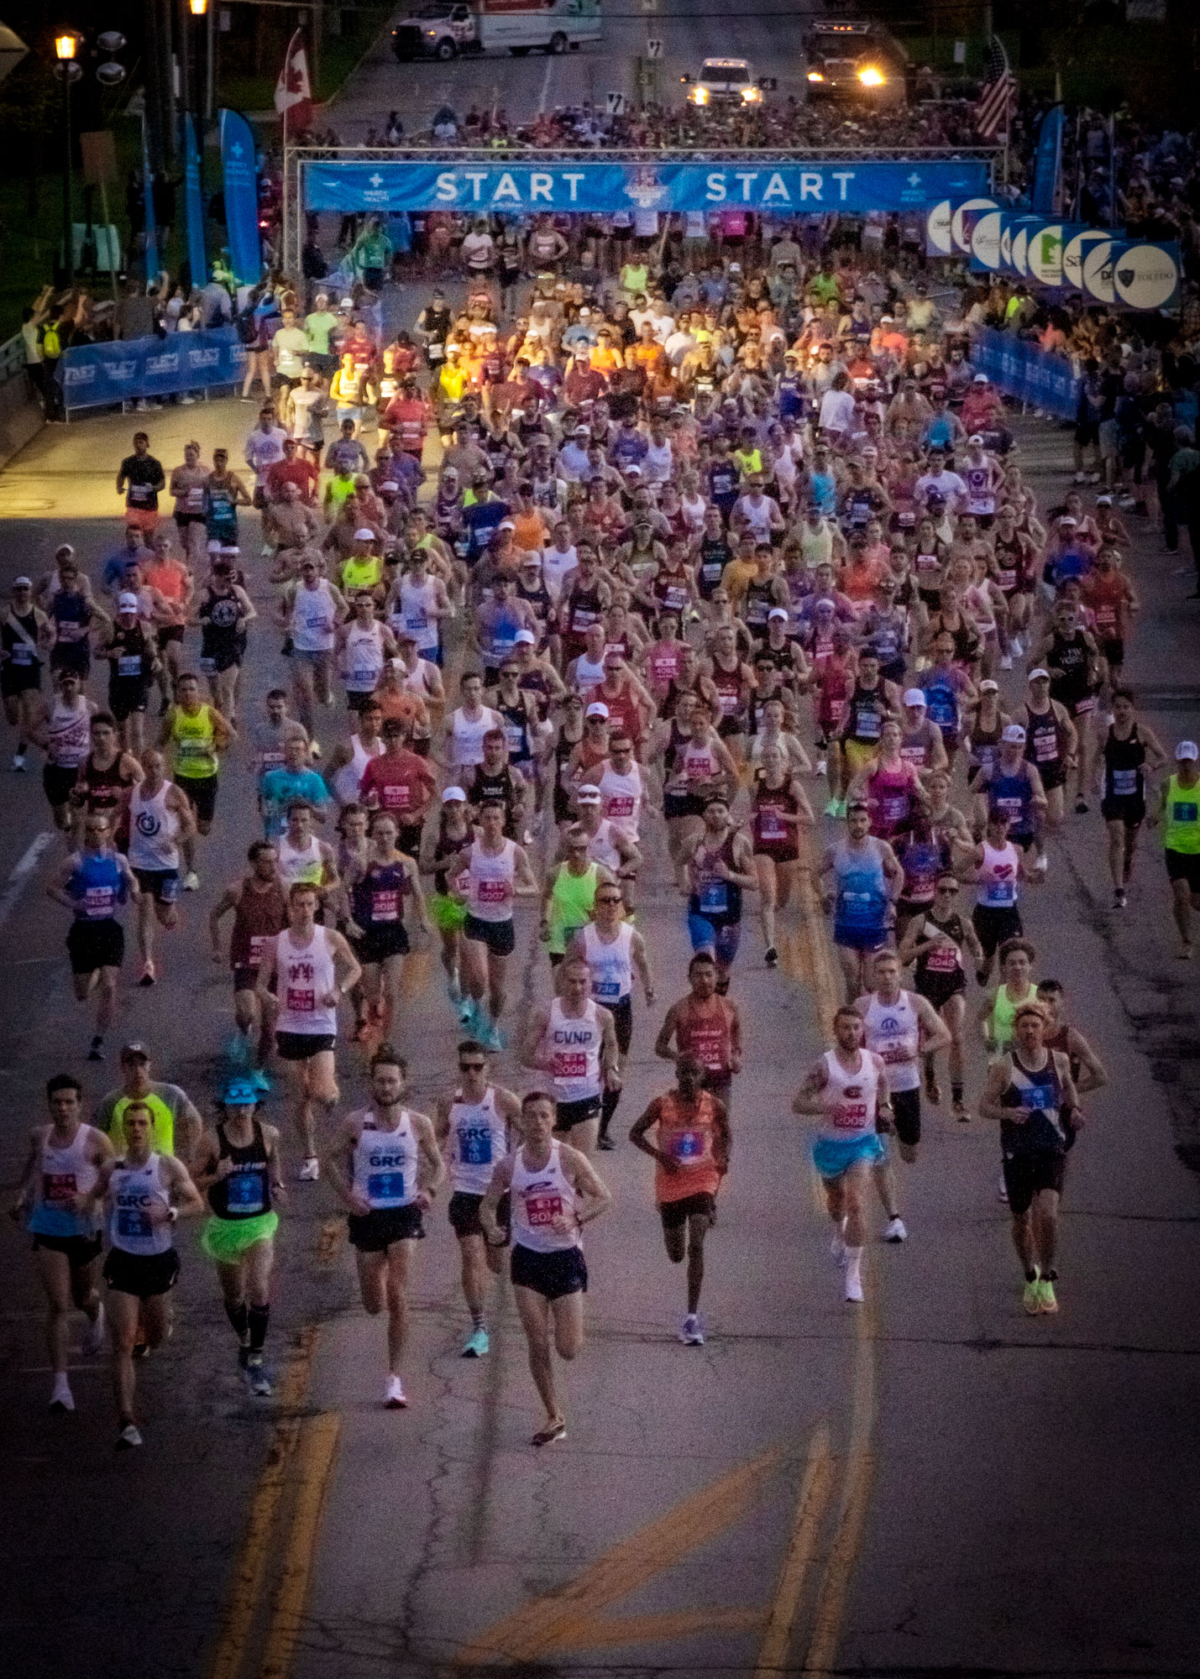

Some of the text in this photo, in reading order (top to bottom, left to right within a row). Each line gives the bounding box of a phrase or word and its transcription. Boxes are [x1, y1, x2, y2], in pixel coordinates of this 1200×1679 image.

[436, 172, 585, 201] START
[706, 172, 855, 201] START
[1137, 272, 1173, 282] TOLEDO
[554, 1031, 592, 1044] CVNP
[457, 1128, 491, 1139] GRC
[370, 1156, 405, 1167] GRC
[116, 1195, 153, 1207] GRC
